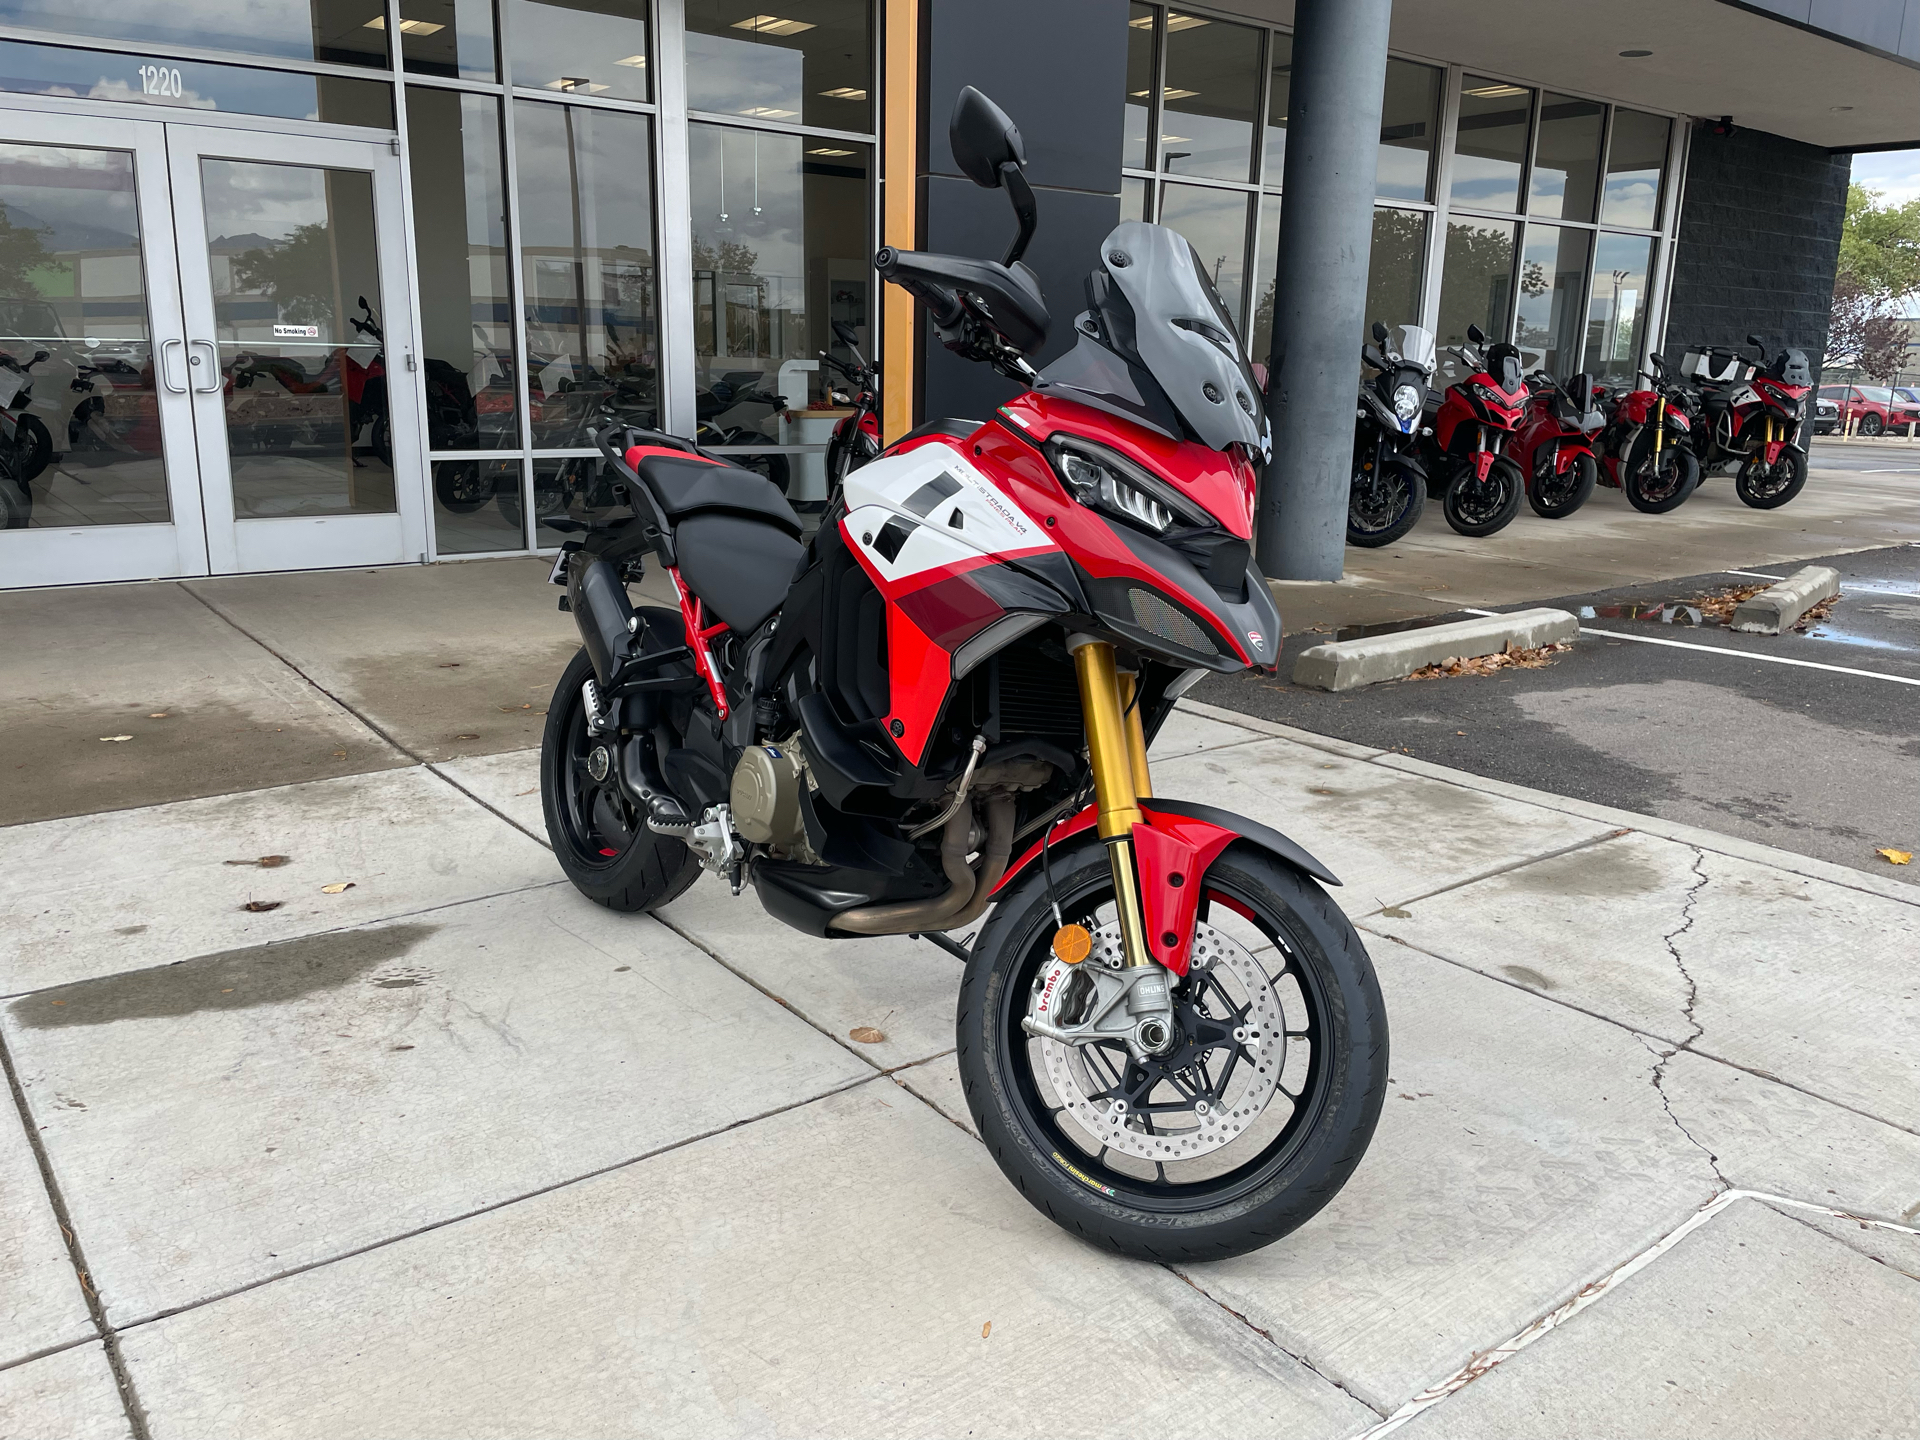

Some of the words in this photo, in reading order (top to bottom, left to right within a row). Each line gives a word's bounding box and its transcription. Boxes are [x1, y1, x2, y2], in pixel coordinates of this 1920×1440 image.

[138, 65, 182, 98] 1220
[284, 328, 306, 336] Smoking
[1016, 521, 1028, 534] V4
[1038, 969, 1061, 1012] brembo
[1068, 1165, 1102, 1189] marchesini
